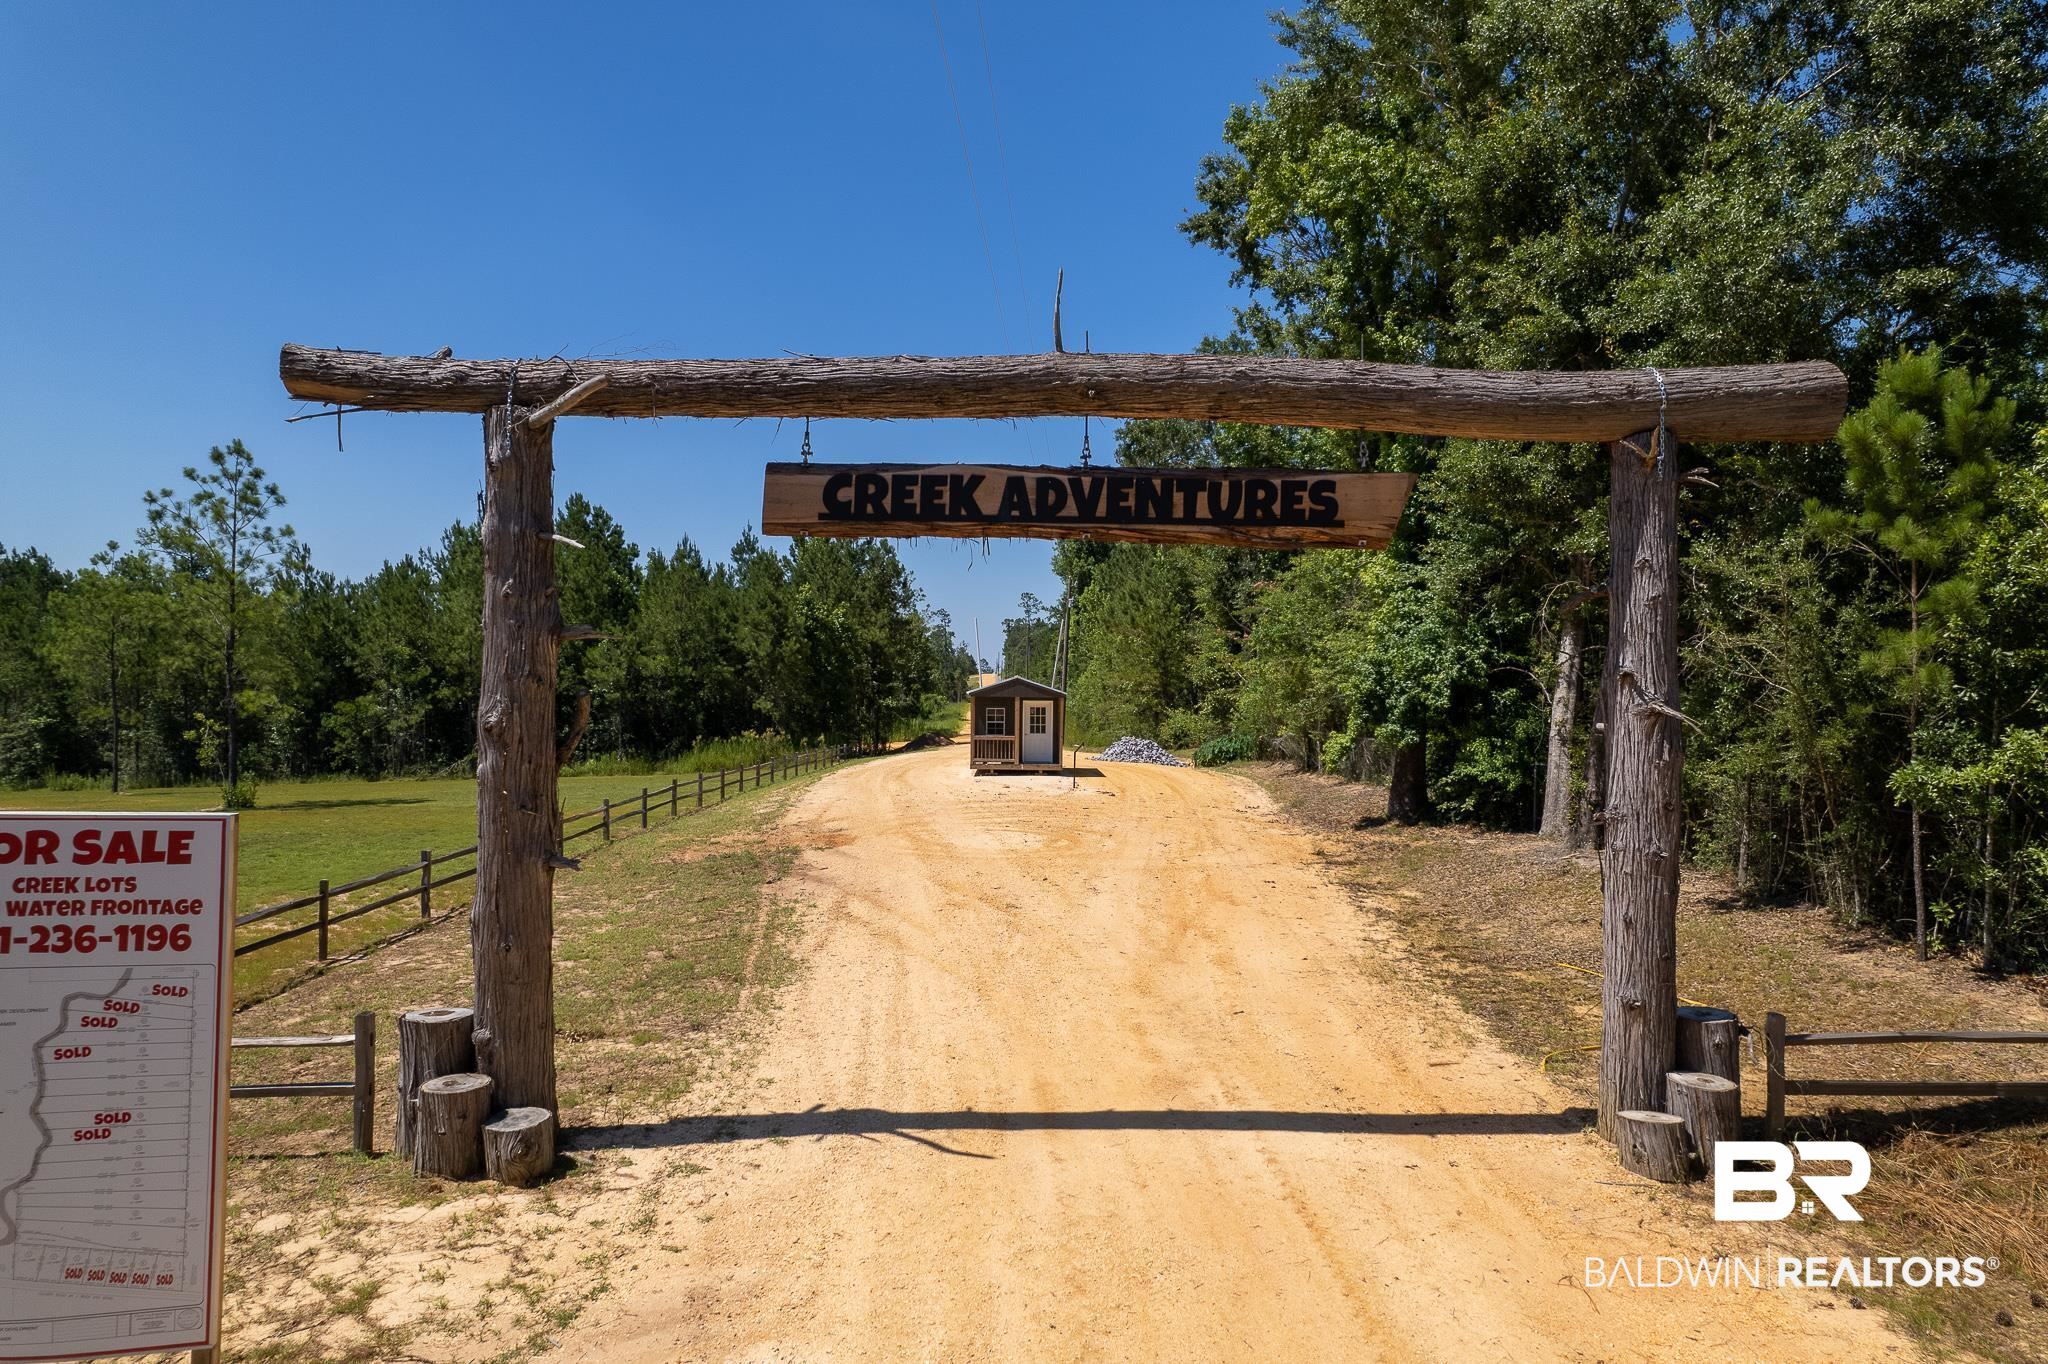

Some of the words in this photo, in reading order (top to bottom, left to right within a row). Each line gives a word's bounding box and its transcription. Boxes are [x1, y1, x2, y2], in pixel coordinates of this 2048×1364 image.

[819, 473, 986, 521] CREEK
[1000, 475, 1345, 528] ADVENTURES
[72, 829, 195, 865] SALE
[12, 877, 80, 894] CREEK
[84, 876, 137, 893] LOTS
[152, 984, 188, 997] SOLD
[103, 1000, 140, 1013] SOLD
[80, 1016, 118, 1028] SOLD
[54, 1045, 92, 1060] SOLD
[94, 1111, 131, 1125] SOLD
[74, 1127, 111, 1141] SOLD
[64, 1268, 83, 1280] SOLD
[87, 1268, 106, 1282] SOLD
[109, 1271, 128, 1284] SOLD
[131, 1272, 149, 1286] SOLD
[156, 1274, 173, 1286] SOLD
